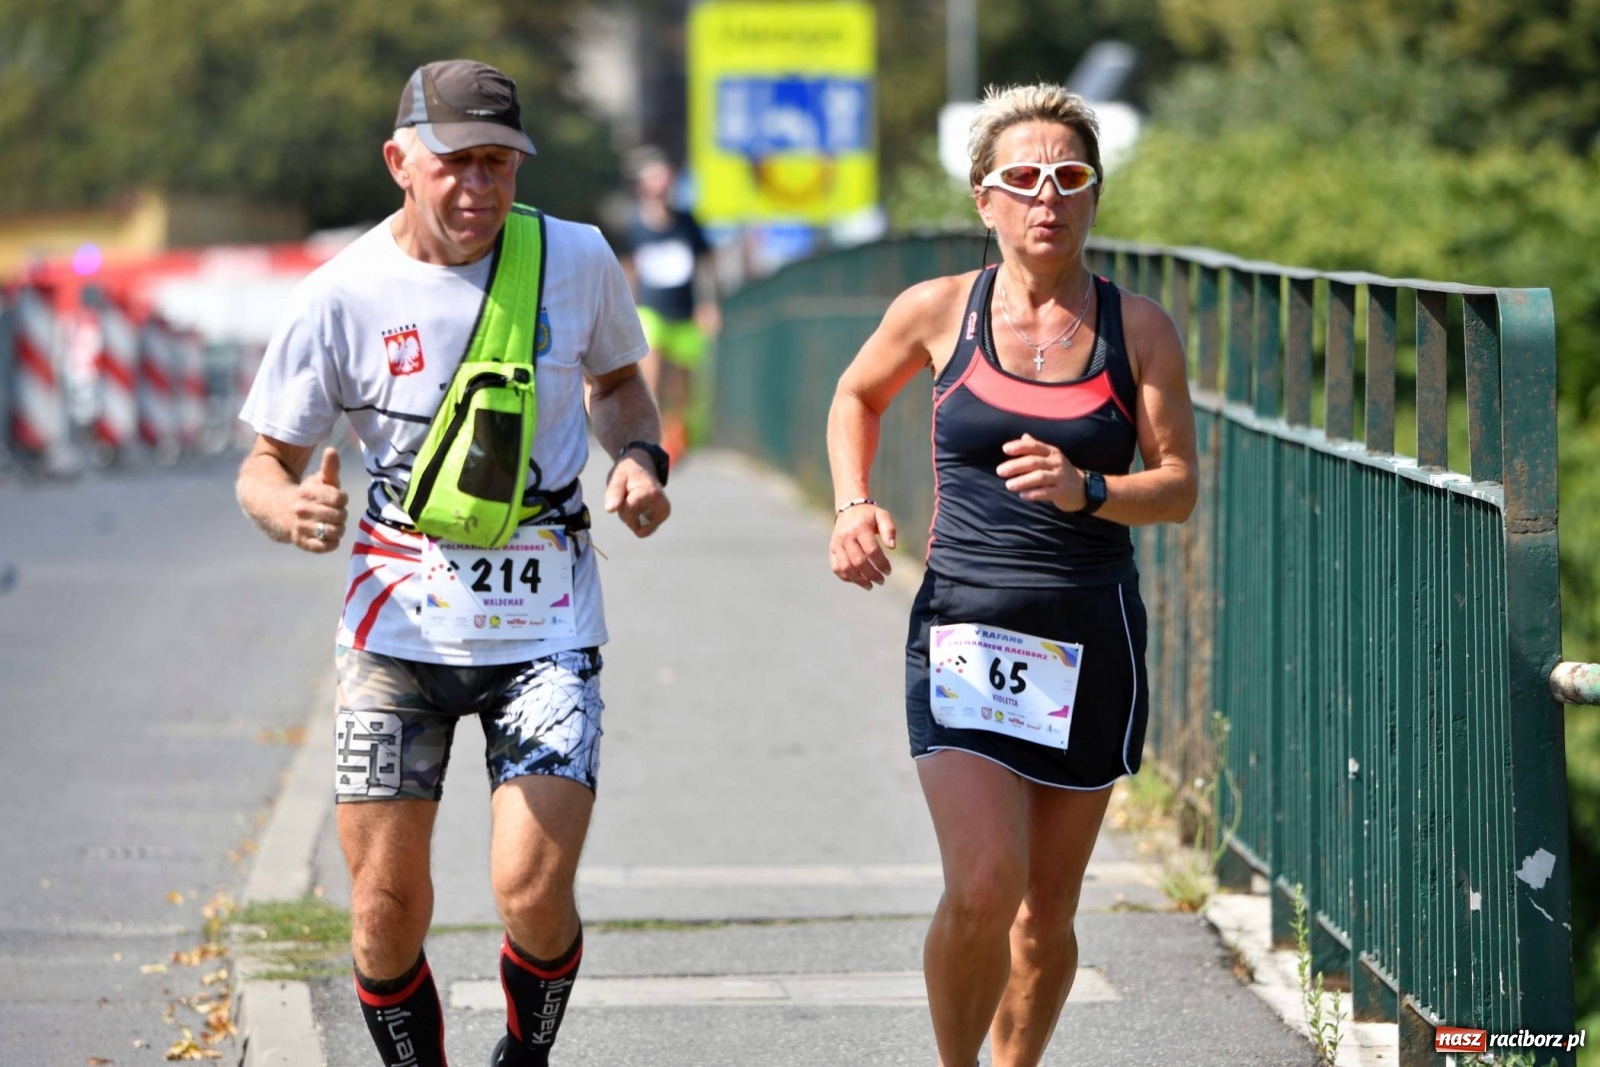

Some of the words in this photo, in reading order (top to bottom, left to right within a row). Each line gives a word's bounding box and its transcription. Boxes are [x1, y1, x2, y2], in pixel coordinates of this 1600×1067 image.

[381, 323, 417, 336] POLSKA
[471, 557, 541, 594] 214
[483, 598, 524, 607] WALDEMAR
[982, 630, 1024, 645] RAFAKO
[989, 657, 1028, 695] 65
[992, 693, 1019, 708] VIOLETTA
[532, 977, 573, 1044] kalenji
